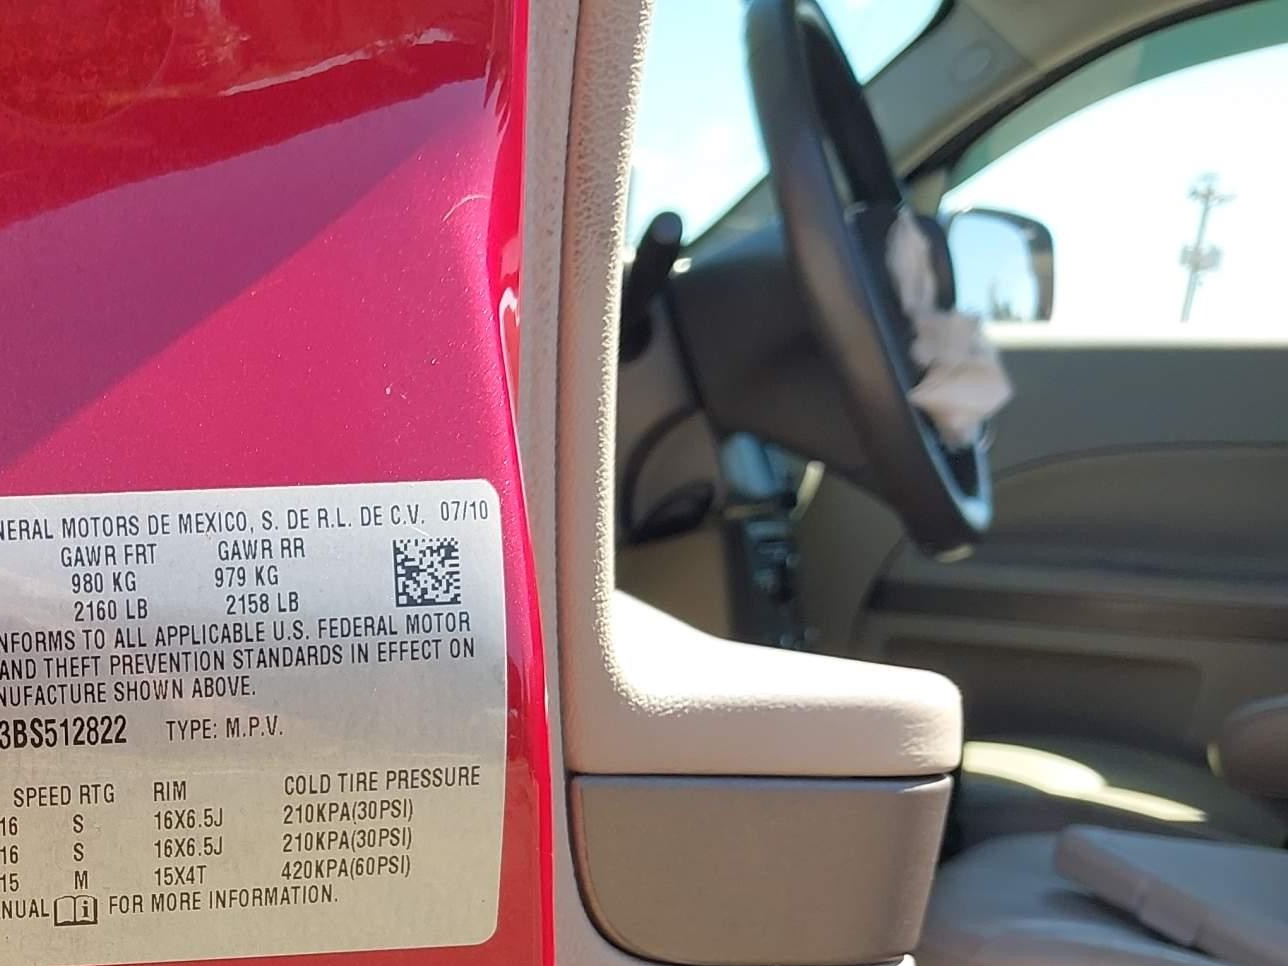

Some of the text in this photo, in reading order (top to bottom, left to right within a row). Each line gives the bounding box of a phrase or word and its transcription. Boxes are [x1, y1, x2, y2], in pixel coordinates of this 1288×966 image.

[62, 515, 139, 539] MOTORS
[149, 514, 170, 535] DE
[179, 512, 255, 534] MEXICO,
[263, 511, 278, 531] S.
[287, 509, 309, 530] DE
[318, 507, 352, 528] R.L.
[361, 505, 382, 526] DE
[391, 504, 425, 525] C.V.
[440, 500, 488, 521] 07/10
[61, 544, 157, 567] GAWR FRT
[218, 538, 305, 561] GAWR RR
[71, 571, 136, 594] 980 KG
[215, 566, 279, 588] 979 KG
[74, 599, 147, 622] 2160 LB
[226, 592, 298, 615] 2158 LB
[82, 629, 104, 649] TO
[114, 628, 147, 648] ALL
[156, 621, 264, 646] APPLICABLE
[273, 620, 309, 641] U.S.
[318, 615, 398, 639] FEDERAL
[406, 612, 471, 634] MOTOR
[0, 658, 36, 680] AND
[44, 655, 101, 678] THEFT
[110, 649, 224, 675] PREVENTION
[233, 644, 342, 670] STANDARDS
[352, 642, 369, 664] IN
[378, 640, 441, 662] EFFECT
[450, 638, 475, 659] ON
[114, 680, 183, 703] SHOWN
[192, 675, 256, 698] ABOVE.
[166, 719, 217, 741] TYPE:
[226, 715, 283, 739] M.P.V.
[285, 765, 481, 796] COLD TIRE PRESSURE
[13, 786, 71, 808] SPEED
[80, 783, 115, 805] RTG
[153, 781, 187, 802] RIM
[73, 814, 84, 833] S
[154, 808, 223, 830] 16X6.5J
[283, 798, 414, 825] 210KPA(30PSI)
[73, 843, 84, 862] S
[154, 836, 223, 858] 16X6.5J
[282, 827, 412, 853] 210KPA(30PSI)
[74, 870, 88, 890] M
[154, 865, 206, 886] 15X4T
[281, 854, 411, 881] 420KPA(60PSI)
[109, 894, 143, 915] FOR
[152, 891, 201, 913] MORE
[209, 884, 338, 909] INFORMATION.
